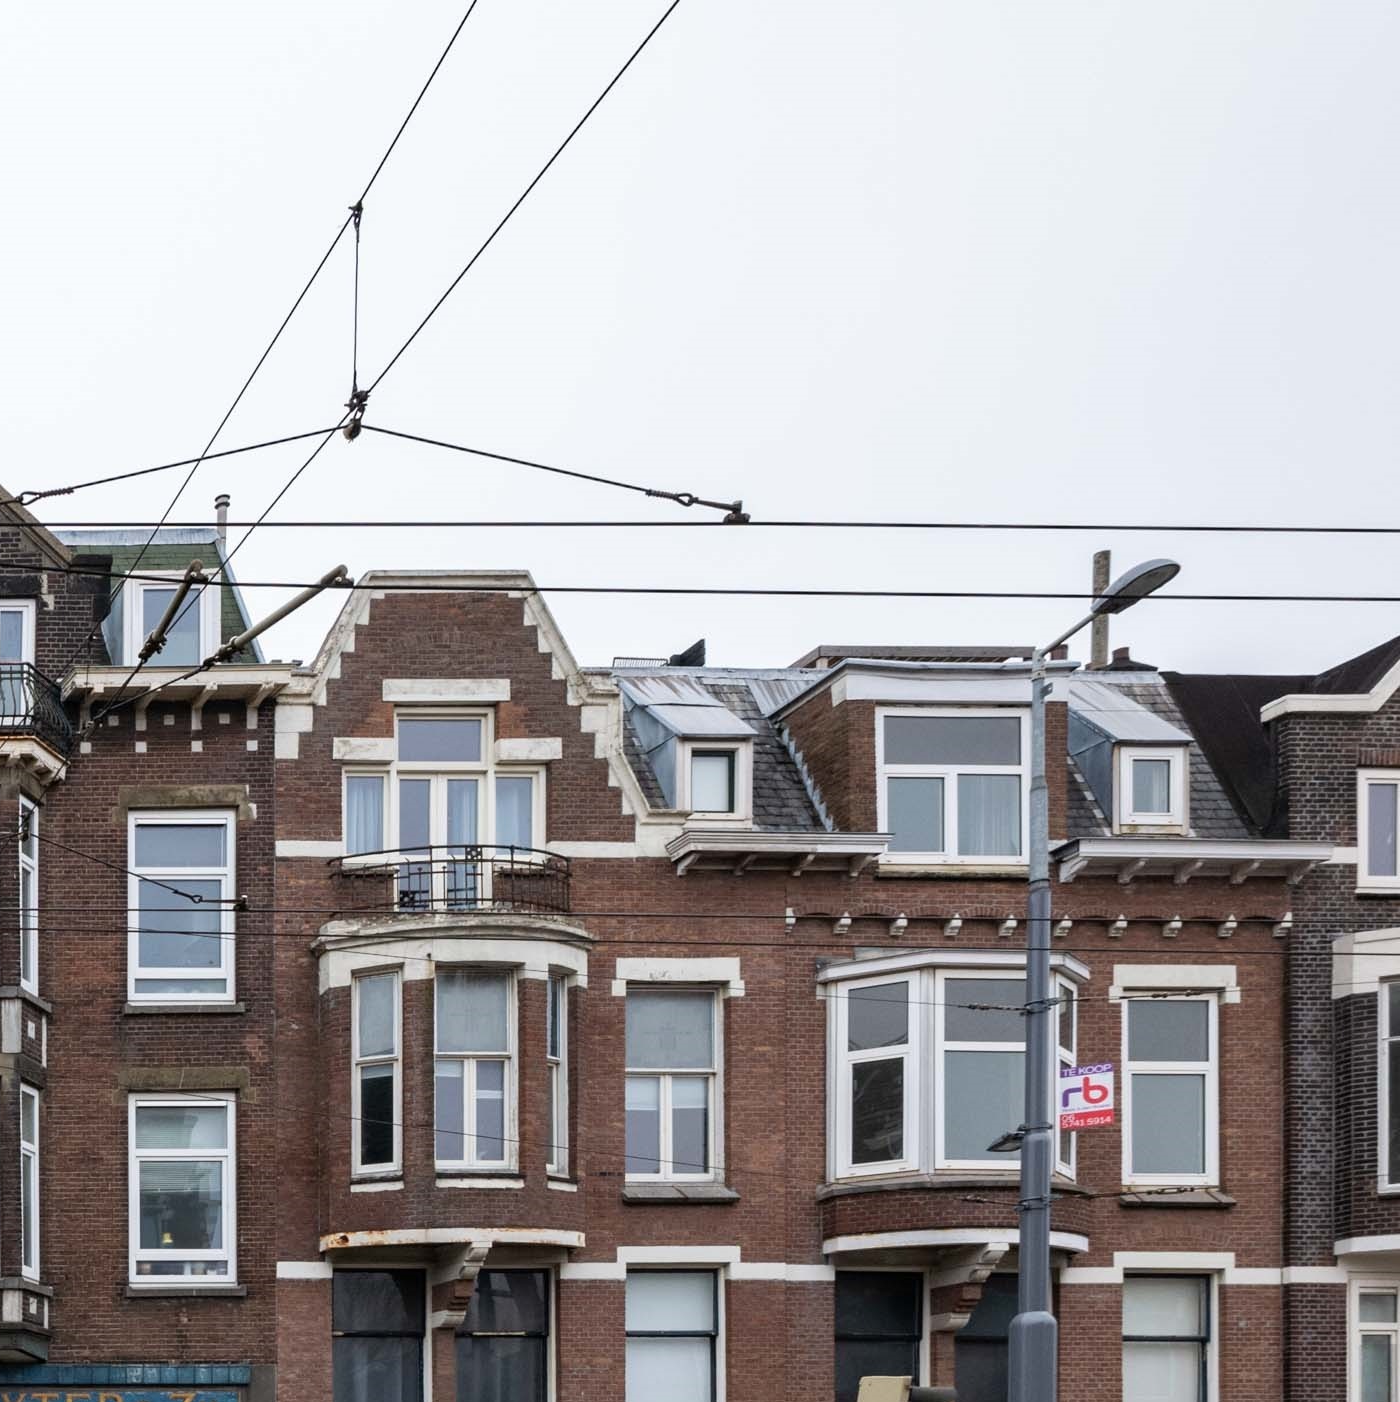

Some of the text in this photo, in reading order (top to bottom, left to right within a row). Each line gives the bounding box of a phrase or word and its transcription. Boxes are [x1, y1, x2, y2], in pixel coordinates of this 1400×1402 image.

[1062, 1064, 1112, 1077] TE KOOP
[1062, 1076, 1108, 1108] rb
